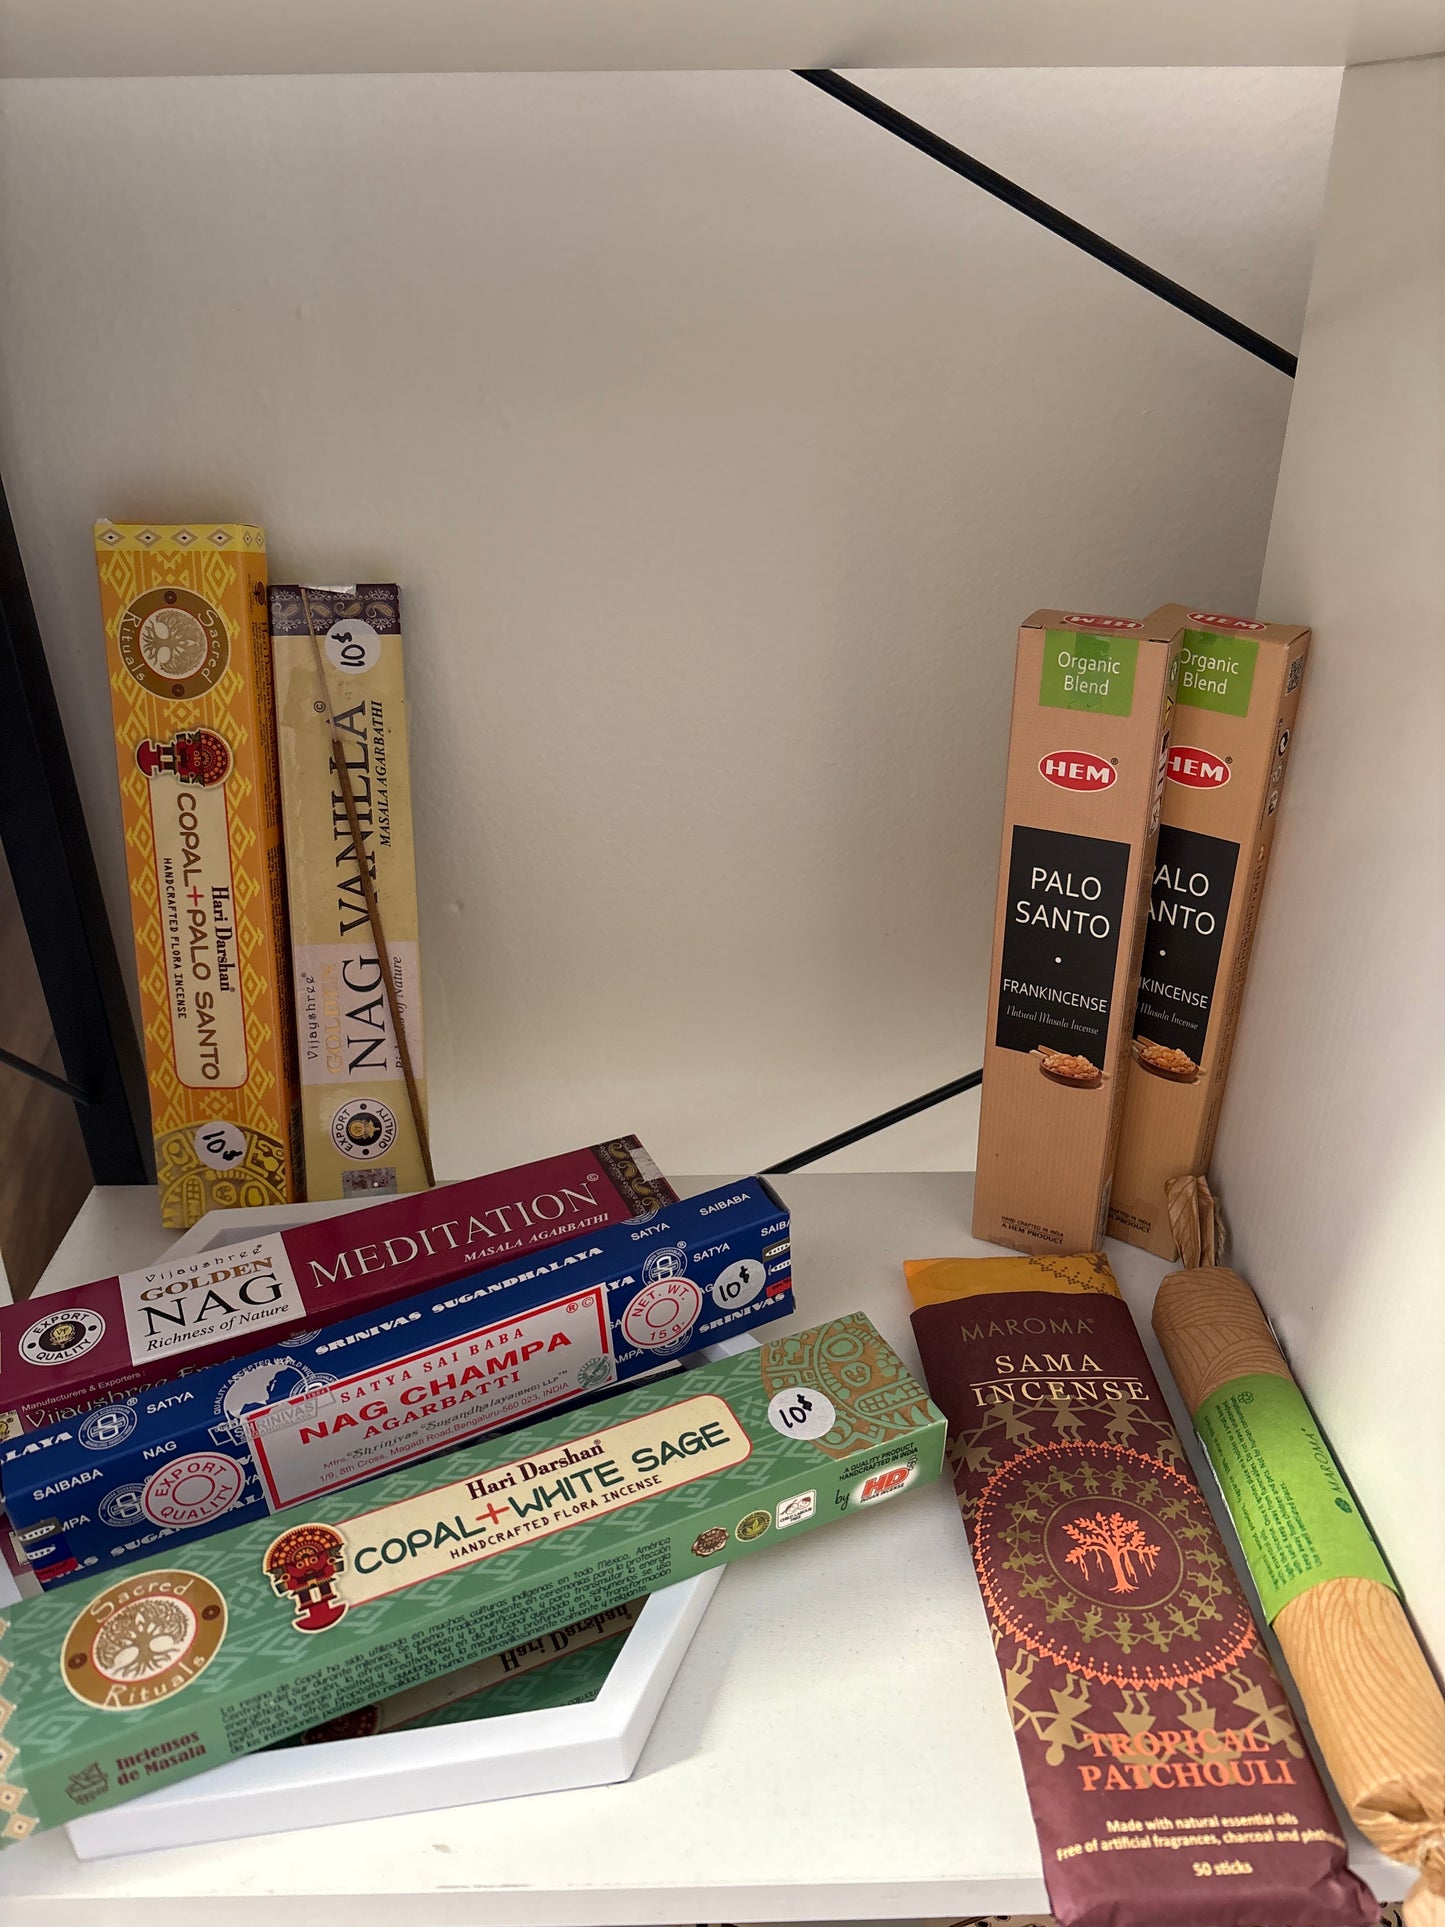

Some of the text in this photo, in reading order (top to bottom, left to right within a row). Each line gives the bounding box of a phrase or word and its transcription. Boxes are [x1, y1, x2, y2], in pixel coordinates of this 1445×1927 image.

[120, 610, 146, 682] Rituals
[197, 608, 222, 685] Sacred
[1057, 651, 1120, 676] Organic
[1063, 674, 1109, 696] Blend
[1183, 672, 1227, 695] Blend
[371, 700, 391, 847] MASALA AGARBATHI
[1031, 867, 1102, 900] PALO
[1154, 864, 1209, 897] ALO
[211, 885, 230, 922] Hari
[1015, 901, 1110, 939] SANTO
[163, 857, 187, 1019] HANDCRAFTED FLORA INCENSE
[1003, 978, 1108, 1014] FRANKINCENSE
[342, 955, 387, 1075] NAG
[1006, 1006, 1099, 1036] Natural Masala Incense
[1140, 1002, 1198, 1031] Masala Incense
[195, 992, 221, 1080] SANTO
[336, 1109, 354, 1152] EXPORT
[377, 1108, 395, 1150] QUALITY
[699, 1193, 751, 1217] SAIBABA
[464, 1213, 609, 1263] MASALA AGARBATHI
[630, 1222, 671, 1242] SATYA
[1027, 1229, 1063, 1245] PRODUCT
[693, 1242, 731, 1262] SATYA
[140, 1256, 273, 1301] GOLDEN
[667, 1284, 689, 1301] WT.
[137, 1272, 284, 1337] NAG
[315, 1311, 423, 1355] SRINIVAS
[431, 1247, 604, 1314] SUGANDHALAYA
[699, 1293, 785, 1334] SRINIVAS
[33, 1312, 90, 1335] EXPORT
[147, 1304, 289, 1351] Richness of Nature
[650, 1329, 667, 1340] 15
[36, 1338, 92, 1361] QUALITY
[340, 1328, 524, 1404] SATYA SAI BABA
[995, 1353, 1104, 1375] SAMA
[21, 1387, 87, 1412] Manufacturers
[89, 1383, 96, 1392] &
[146, 1391, 195, 1414] SATYA
[213, 1385, 229, 1415] QUALITY
[300, 1401, 389, 1445] NAG
[400, 1331, 573, 1406] CHAMPA
[363, 1370, 520, 1439] AGARBATTI
[971, 1380, 1150, 1408] INCENSE
[390, 1439, 425, 1455] Magadi
[543, 1382, 570, 1399] INDIA
[143, 1441, 177, 1460] NAG
[347, 1430, 419, 1460] Shrinivas
[632, 1422, 730, 1472] SAGE
[851, 1455, 881, 1470] QUALITY
[881, 1442, 915, 1459] PRODUCT
[155, 1462, 227, 1498] EXPORT
[839, 1447, 919, 1481] HANDCRAFTED IN INDIA
[33, 1468, 103, 1501] SAIBABA
[465, 1472, 517, 1500] Hari
[862, 1467, 910, 1498] HD
[160, 1485, 233, 1520] QUALITY
[835, 1489, 850, 1510] by
[450, 1474, 663, 1560] HANDCRAFTED FLORA INCENSE
[90, 1579, 195, 1624] Sacred
[103, 1655, 205, 1708] Rituals
[115, 1730, 200, 1770] Inciensos
[1083, 1727, 1271, 1758] TROPICAL
[117, 1744, 207, 1786] de Masala
[1079, 1759, 1297, 1792] PATCHOULI
[1106, 1812, 1298, 1834] Made with natural essential oils
[1056, 1843, 1083, 1862] Free
[1085, 1838, 1099, 1853] of
[1100, 1834, 1152, 1852] artificial
[1153, 1831, 1221, 1851] fragrances,
[1223, 1829, 1275, 1845] charcoal
[1276, 1828, 1300, 1843] and
[1192, 1860, 1254, 1877] 50 sticks
